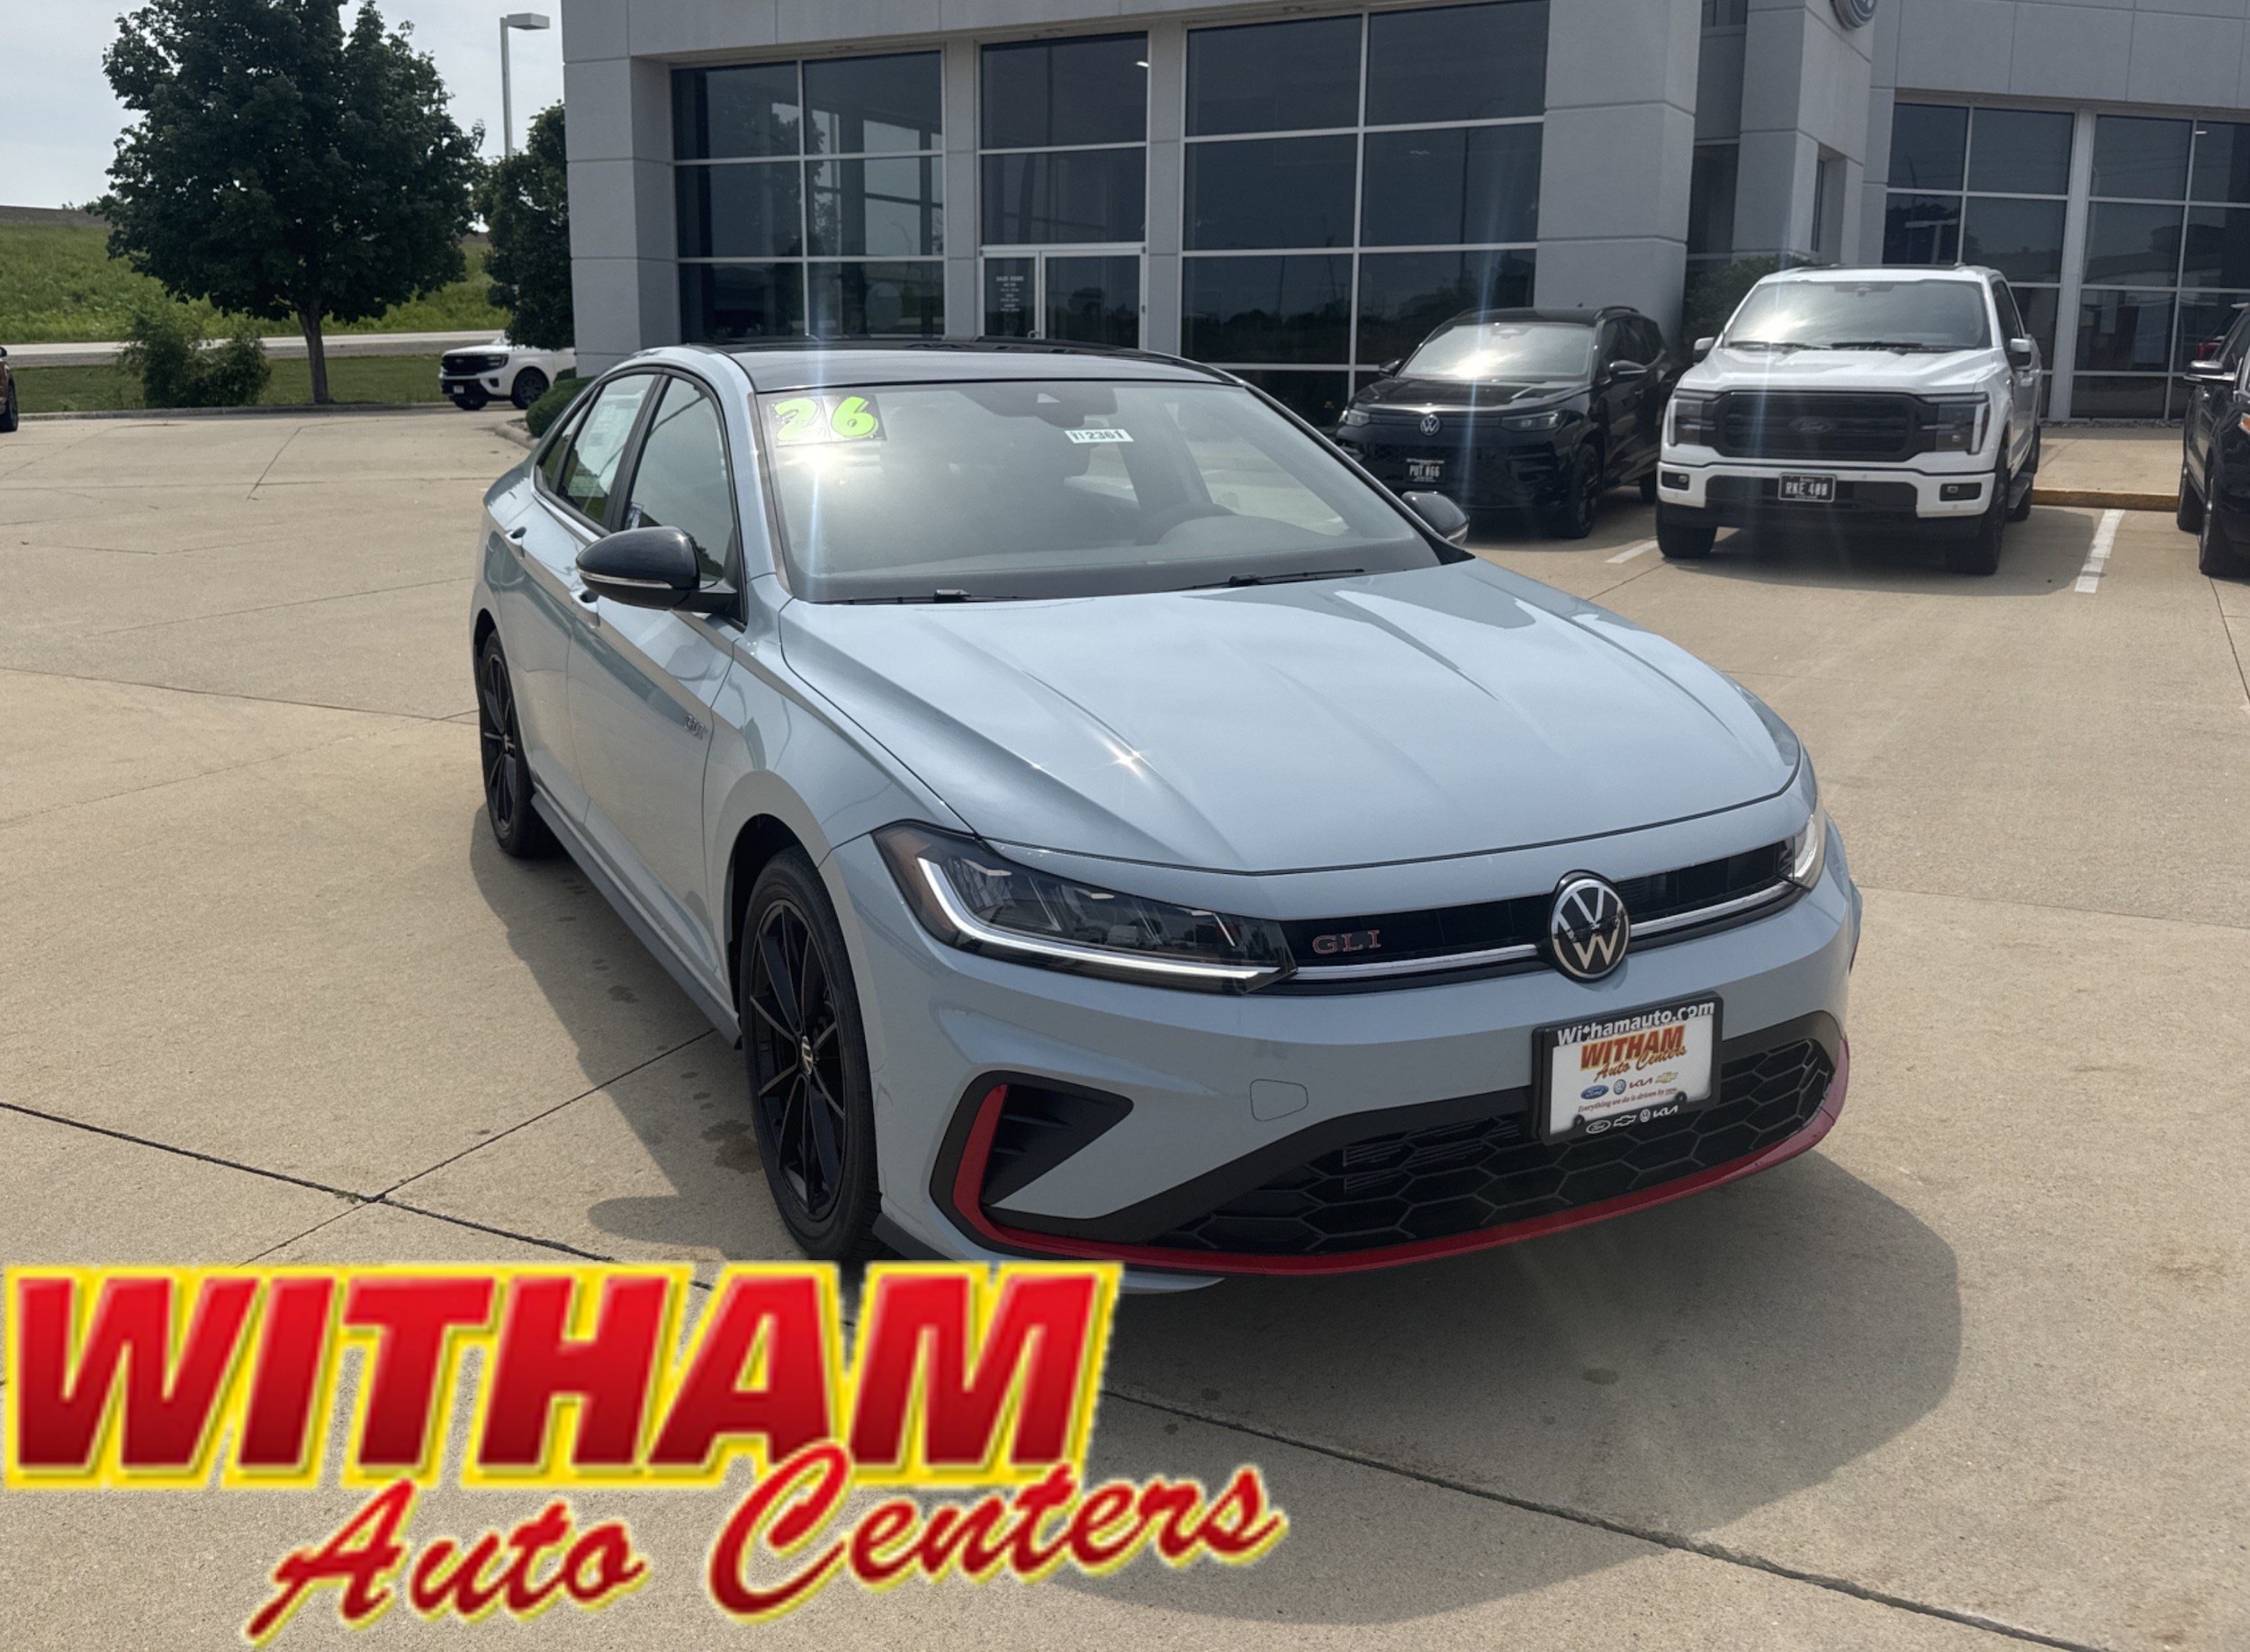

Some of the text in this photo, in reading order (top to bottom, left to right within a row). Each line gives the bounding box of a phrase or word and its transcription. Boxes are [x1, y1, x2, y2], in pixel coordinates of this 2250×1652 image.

[774, 396, 878, 441] 26
[1311, 929, 1382, 956] GLI
[1580, 1025, 1686, 1071] WITHAM
[1593, 1044, 1688, 1083] Auto Centers
